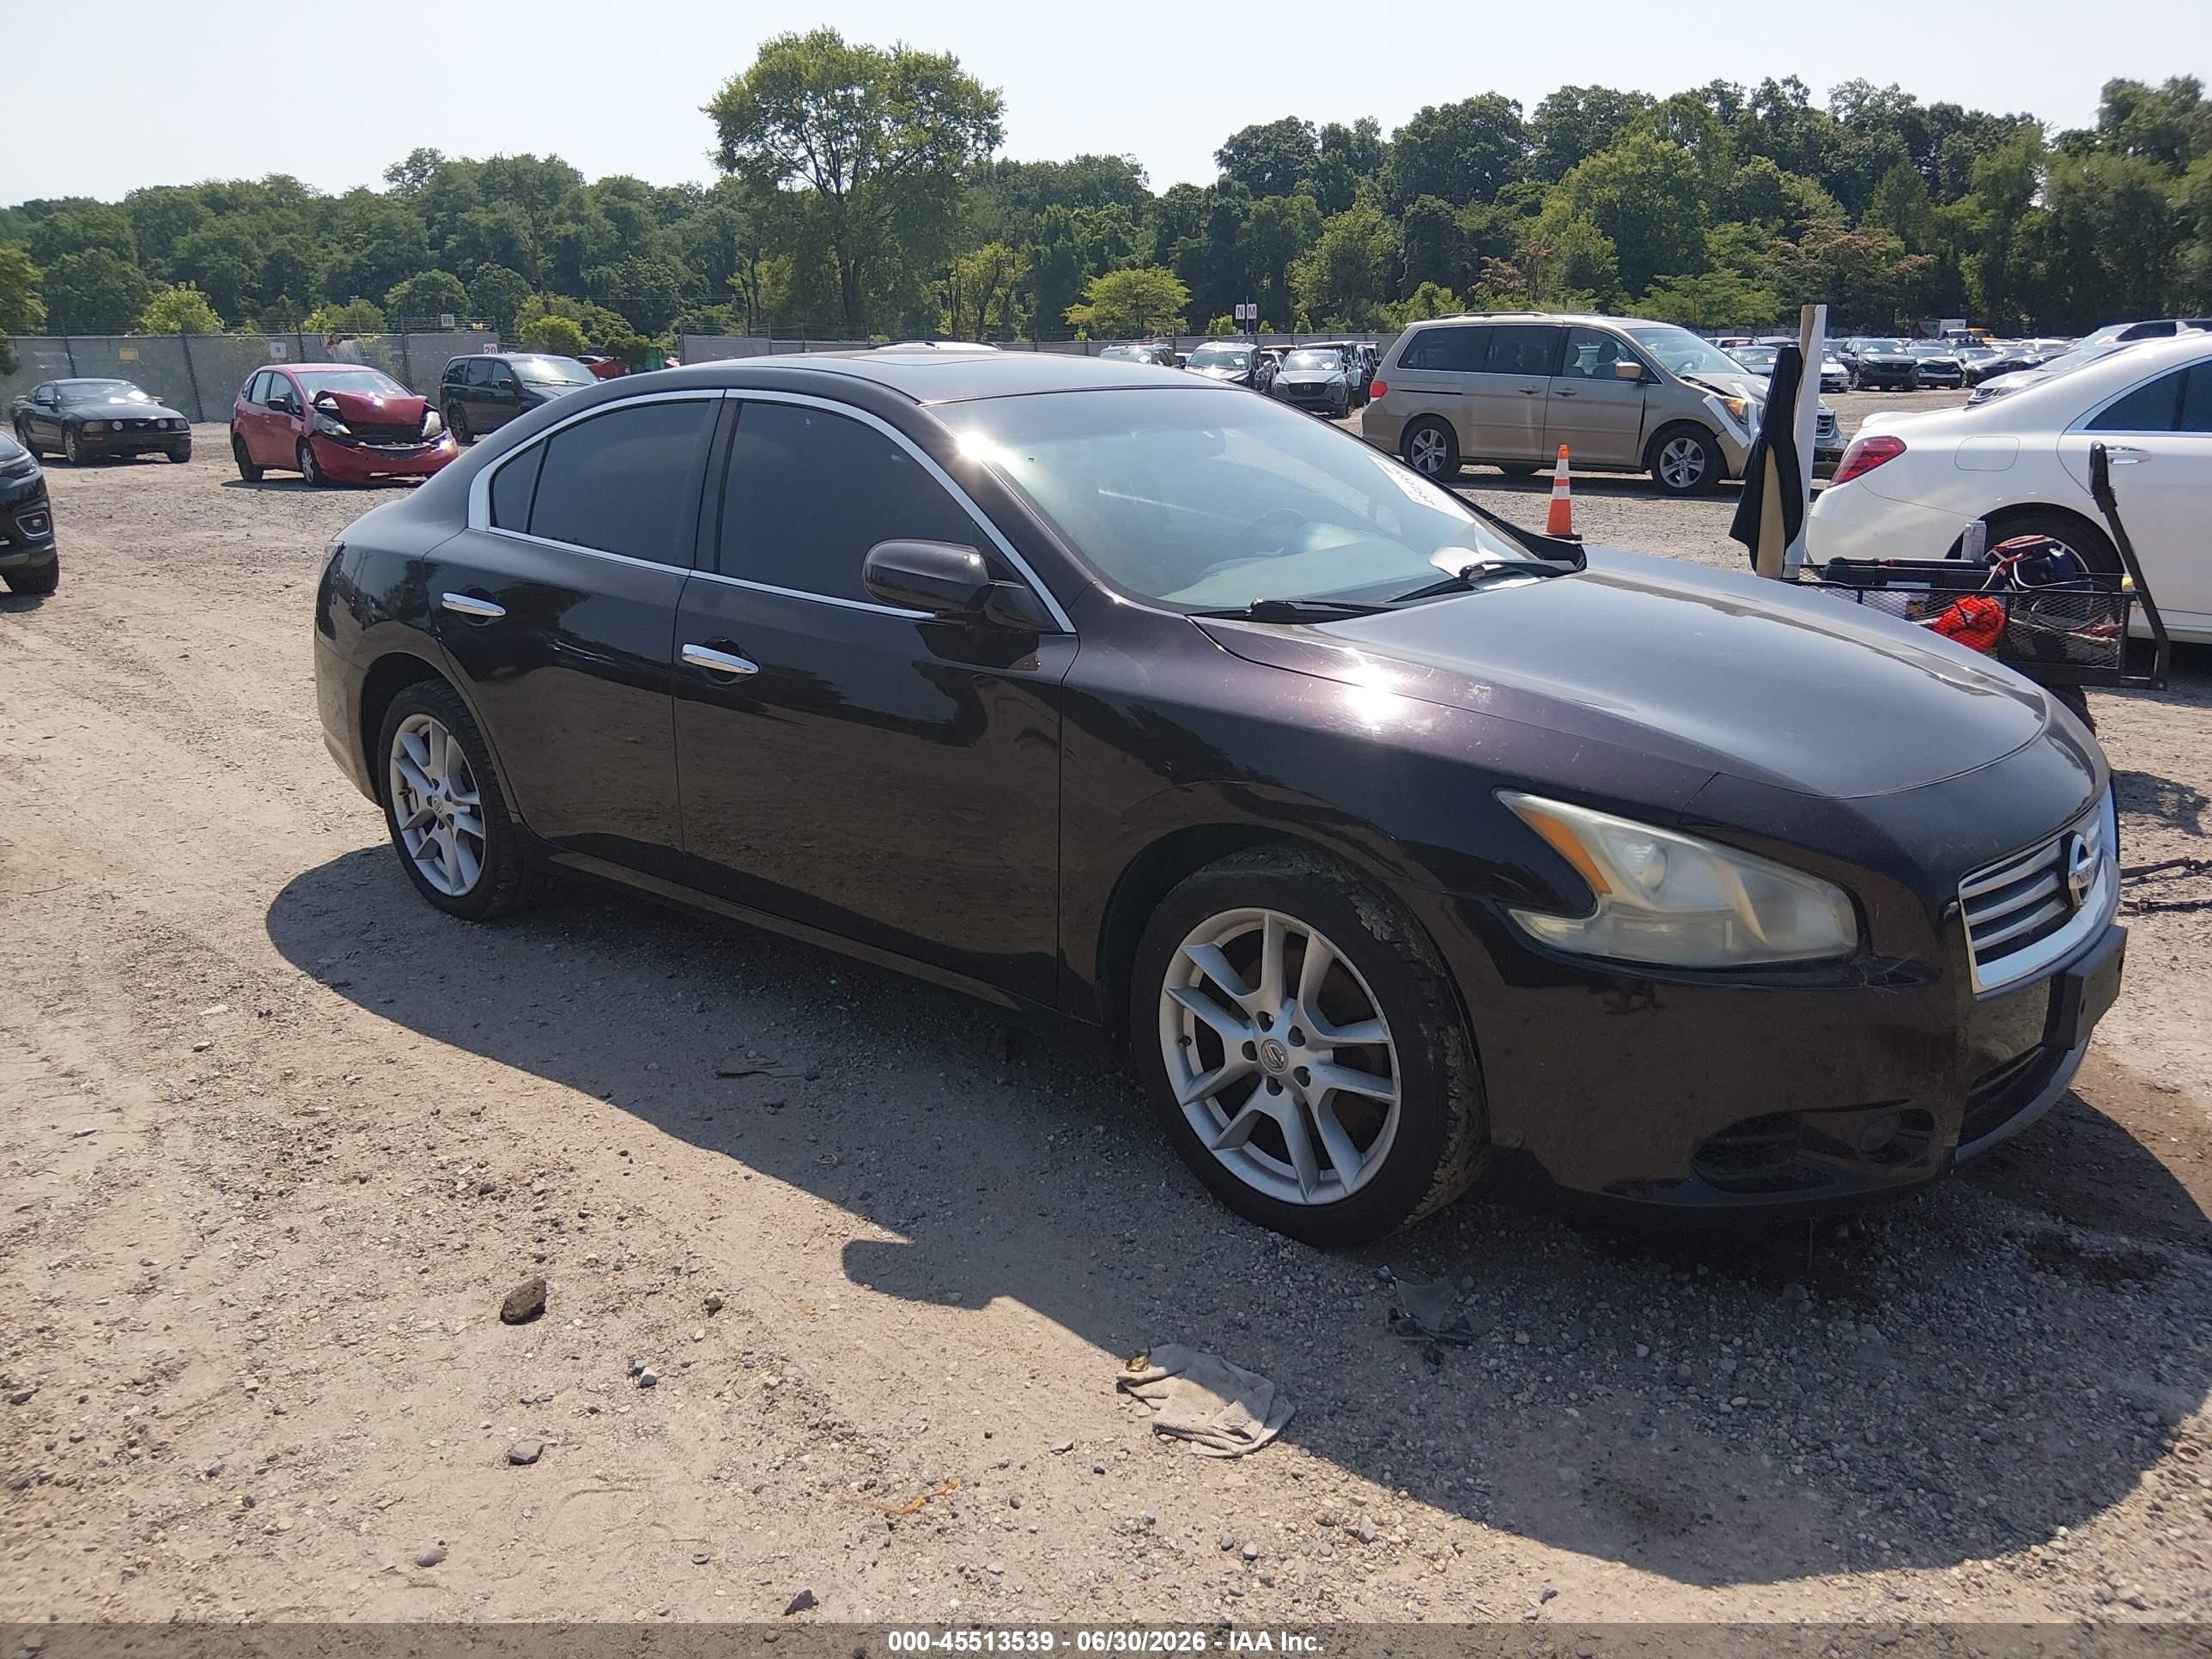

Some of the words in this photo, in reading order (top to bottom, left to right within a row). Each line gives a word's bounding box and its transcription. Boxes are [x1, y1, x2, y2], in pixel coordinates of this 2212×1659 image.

[1237, 306, 1243, 317] N
[1249, 306, 1256, 317] M
[484, 346, 496, 355] 20
